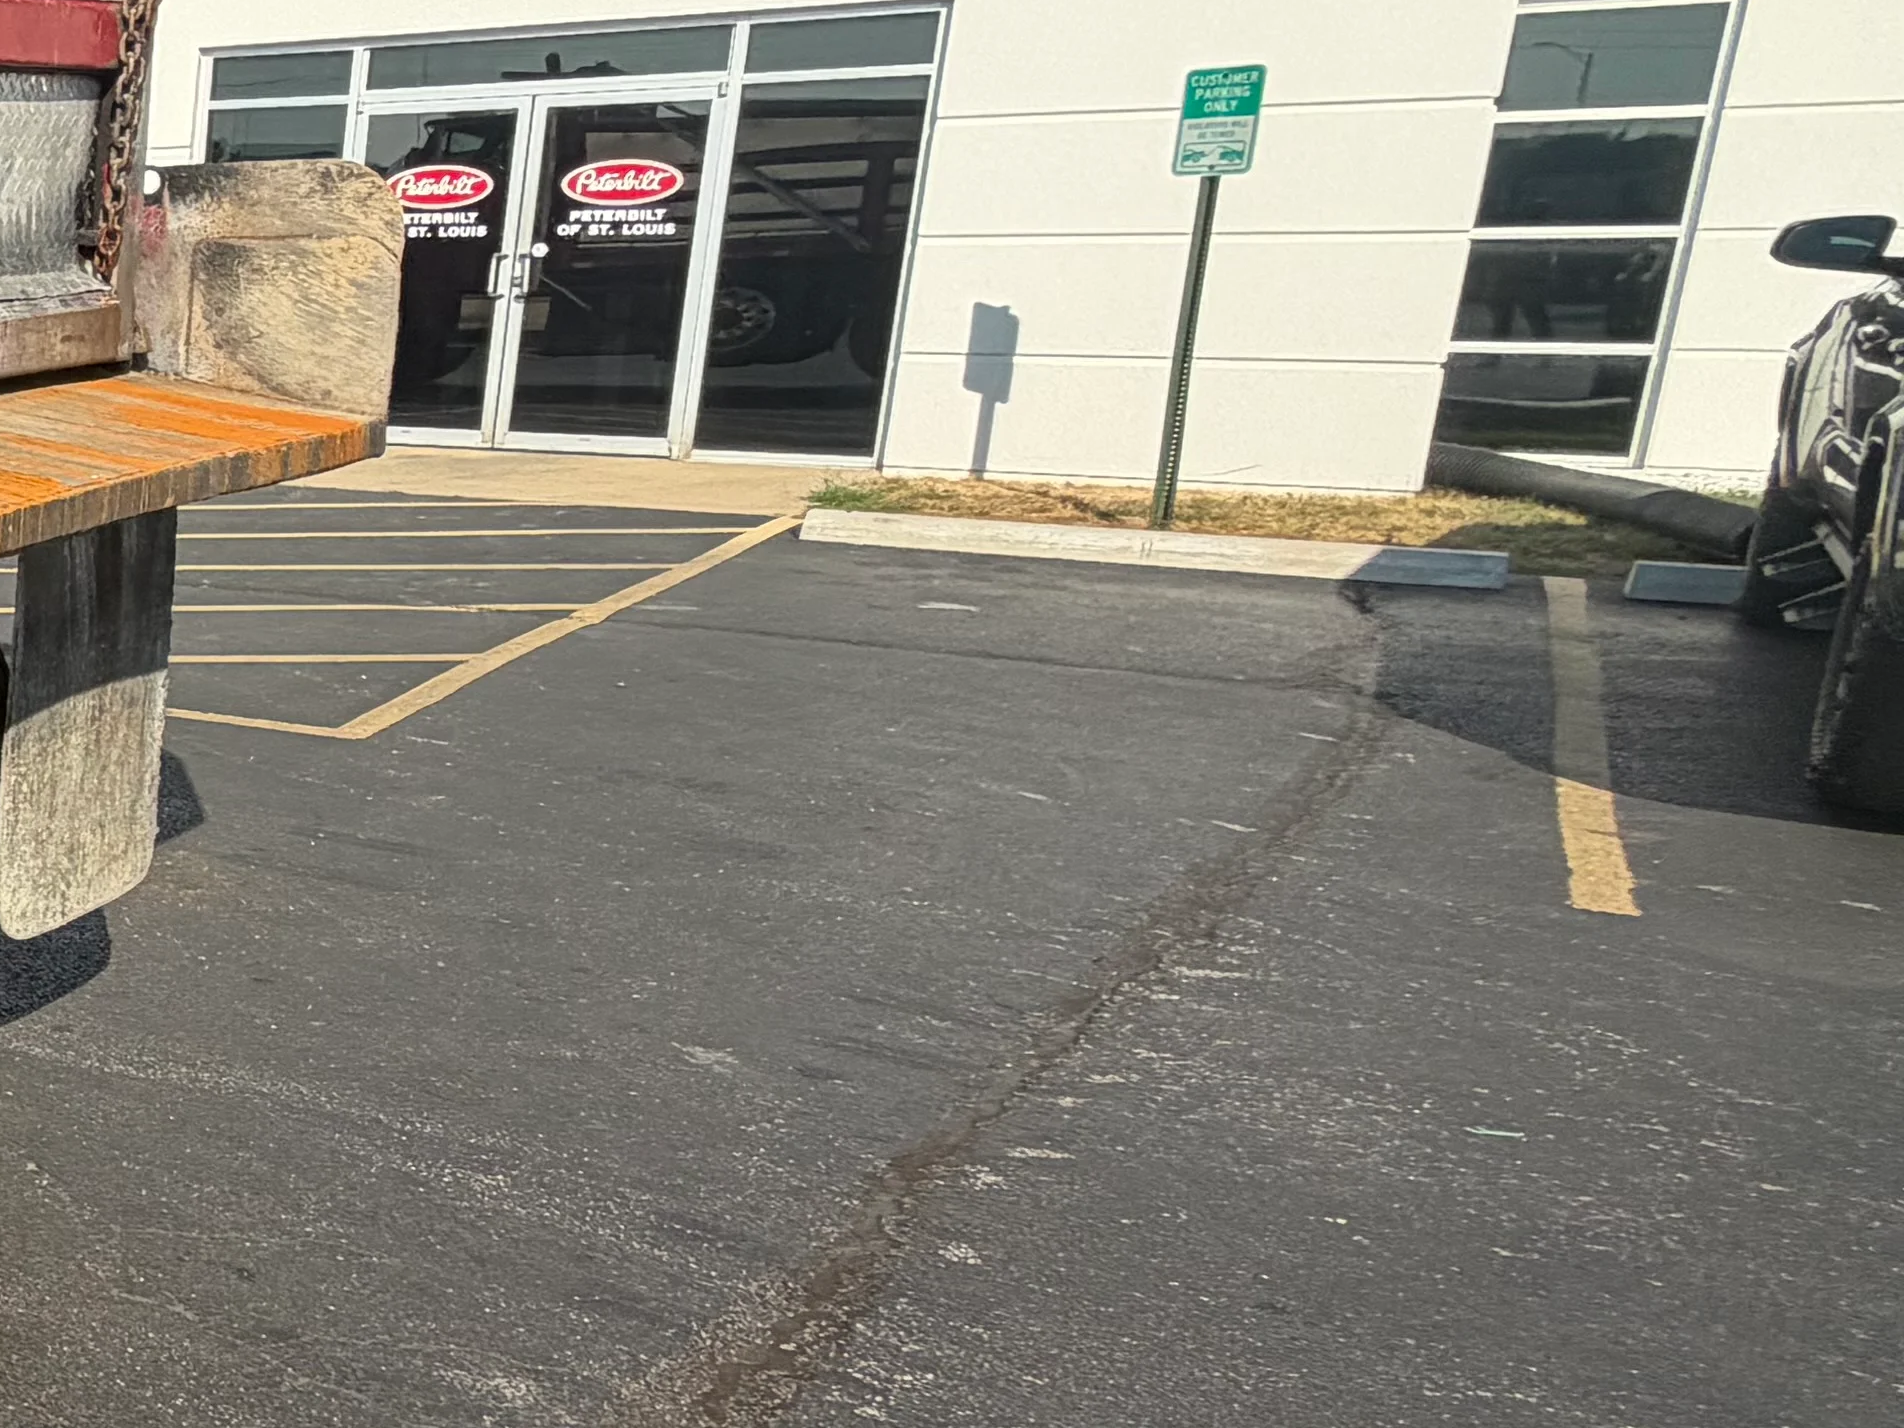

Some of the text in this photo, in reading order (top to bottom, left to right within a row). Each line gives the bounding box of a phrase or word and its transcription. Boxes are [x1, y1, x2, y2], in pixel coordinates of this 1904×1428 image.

[1191, 71, 1259, 87] CUSTOMER
[1194, 86, 1251, 101] PARKING
[1203, 100, 1238, 113] ONLY
[395, 175, 484, 198] Peterbilt
[575, 169, 672, 194] Peterbilt
[403, 212, 479, 225] ETERBILT
[569, 209, 667, 222] PETERBILT
[407, 225, 488, 238] ST. LOUIS
[557, 223, 676, 236] OF ST. LOUIS
